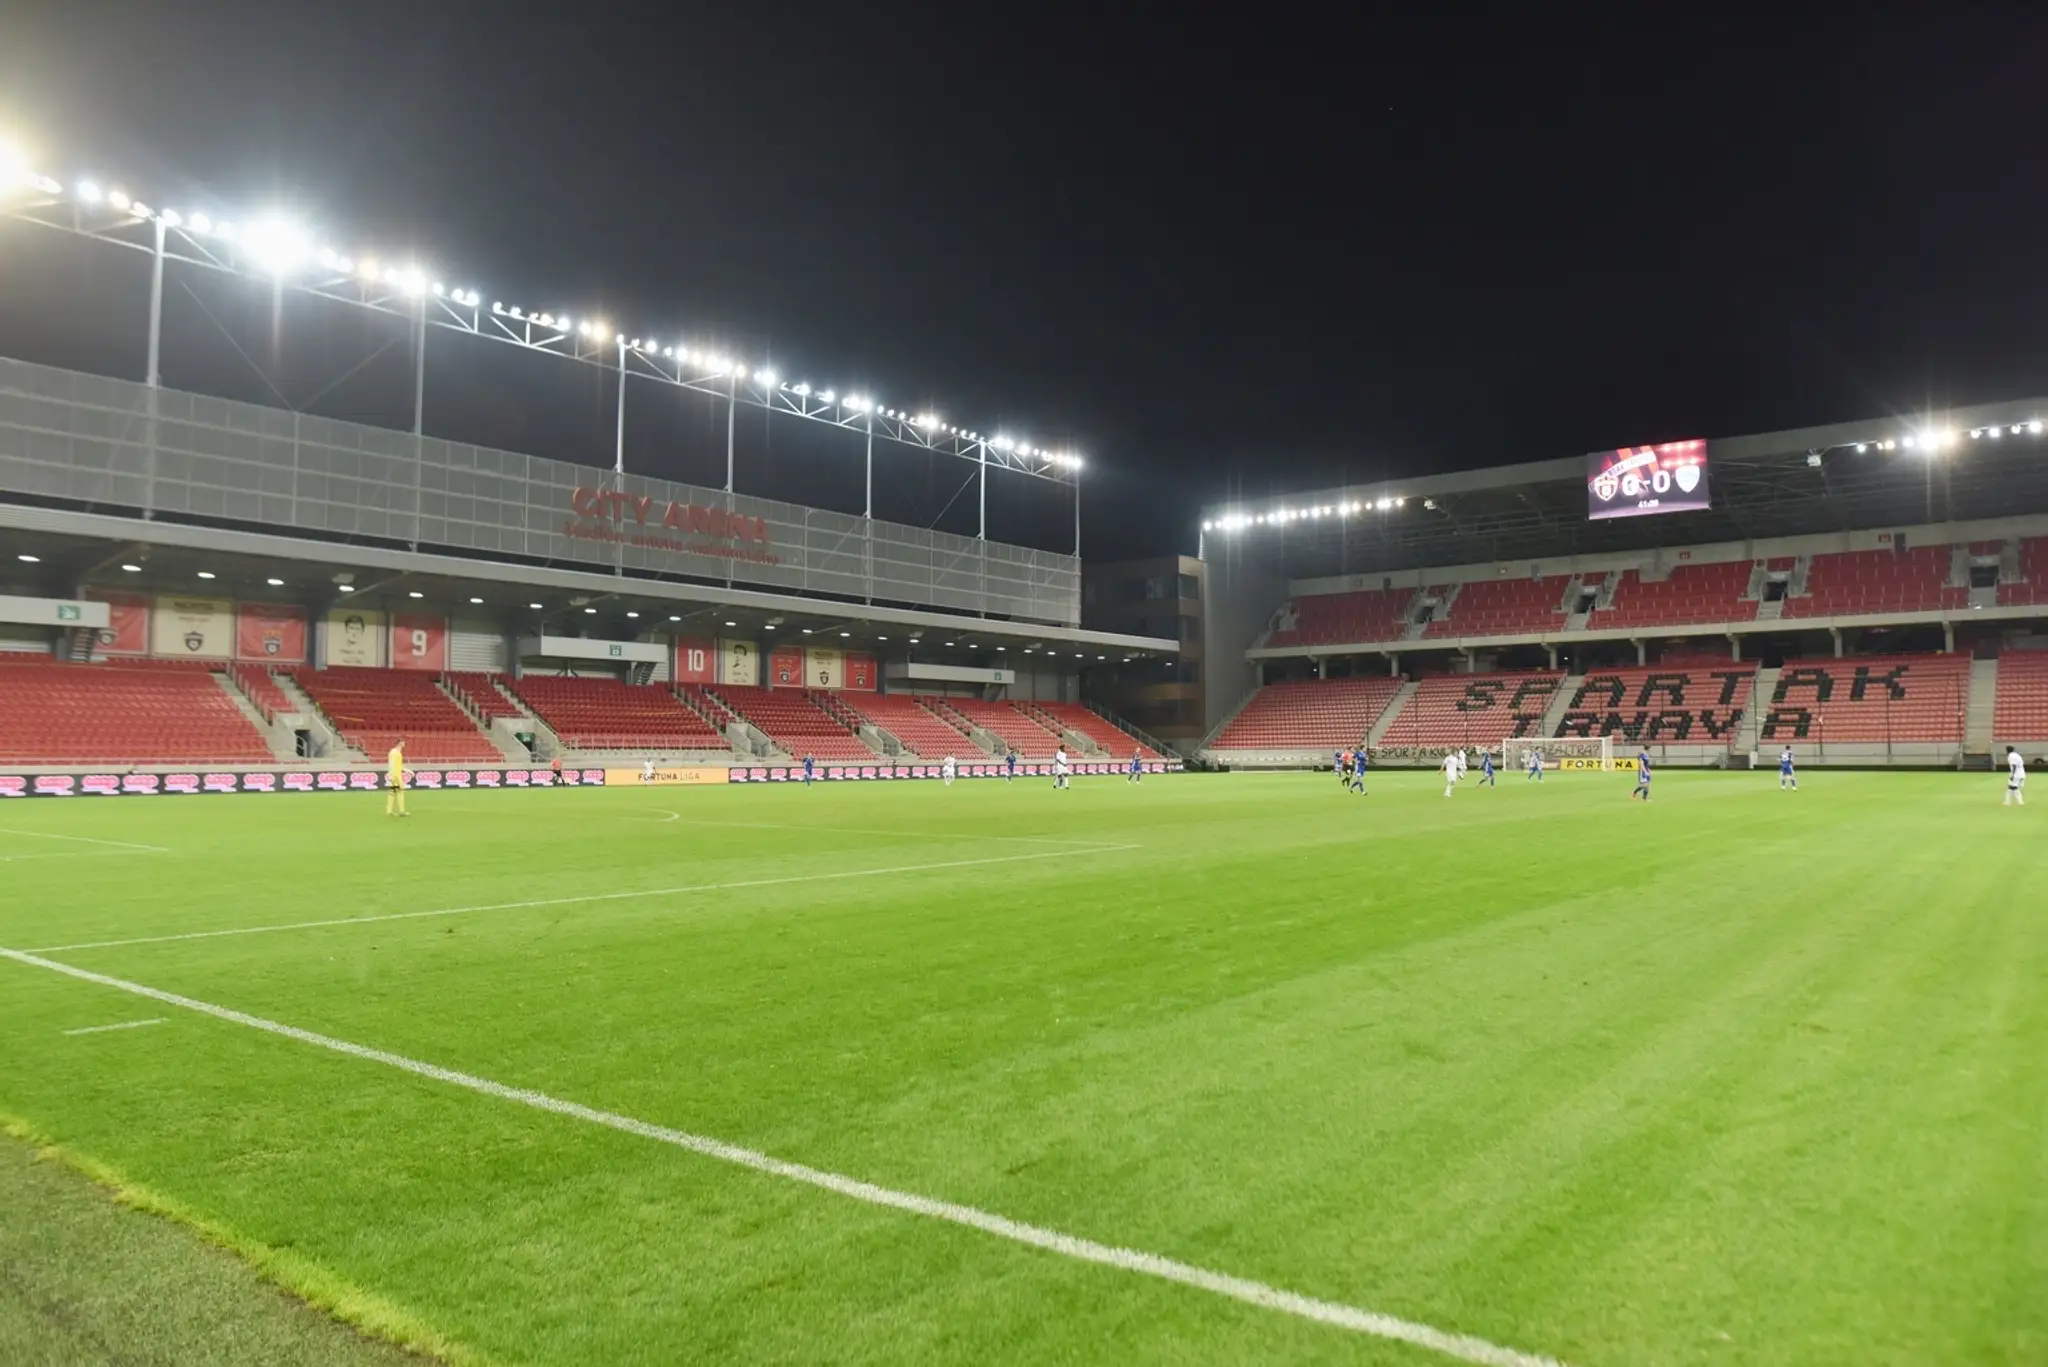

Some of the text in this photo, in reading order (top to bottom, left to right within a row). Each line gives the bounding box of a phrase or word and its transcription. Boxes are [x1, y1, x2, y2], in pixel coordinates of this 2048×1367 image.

[573, 487, 769, 543] CITY ARENA
[411, 629, 428, 657] 9
[687, 648, 705, 672] 10
[1456, 664, 1909, 712] SPARTAK
[1509, 707, 1812, 741] TRNAVA
[680, 772, 700, 780] LIGA
